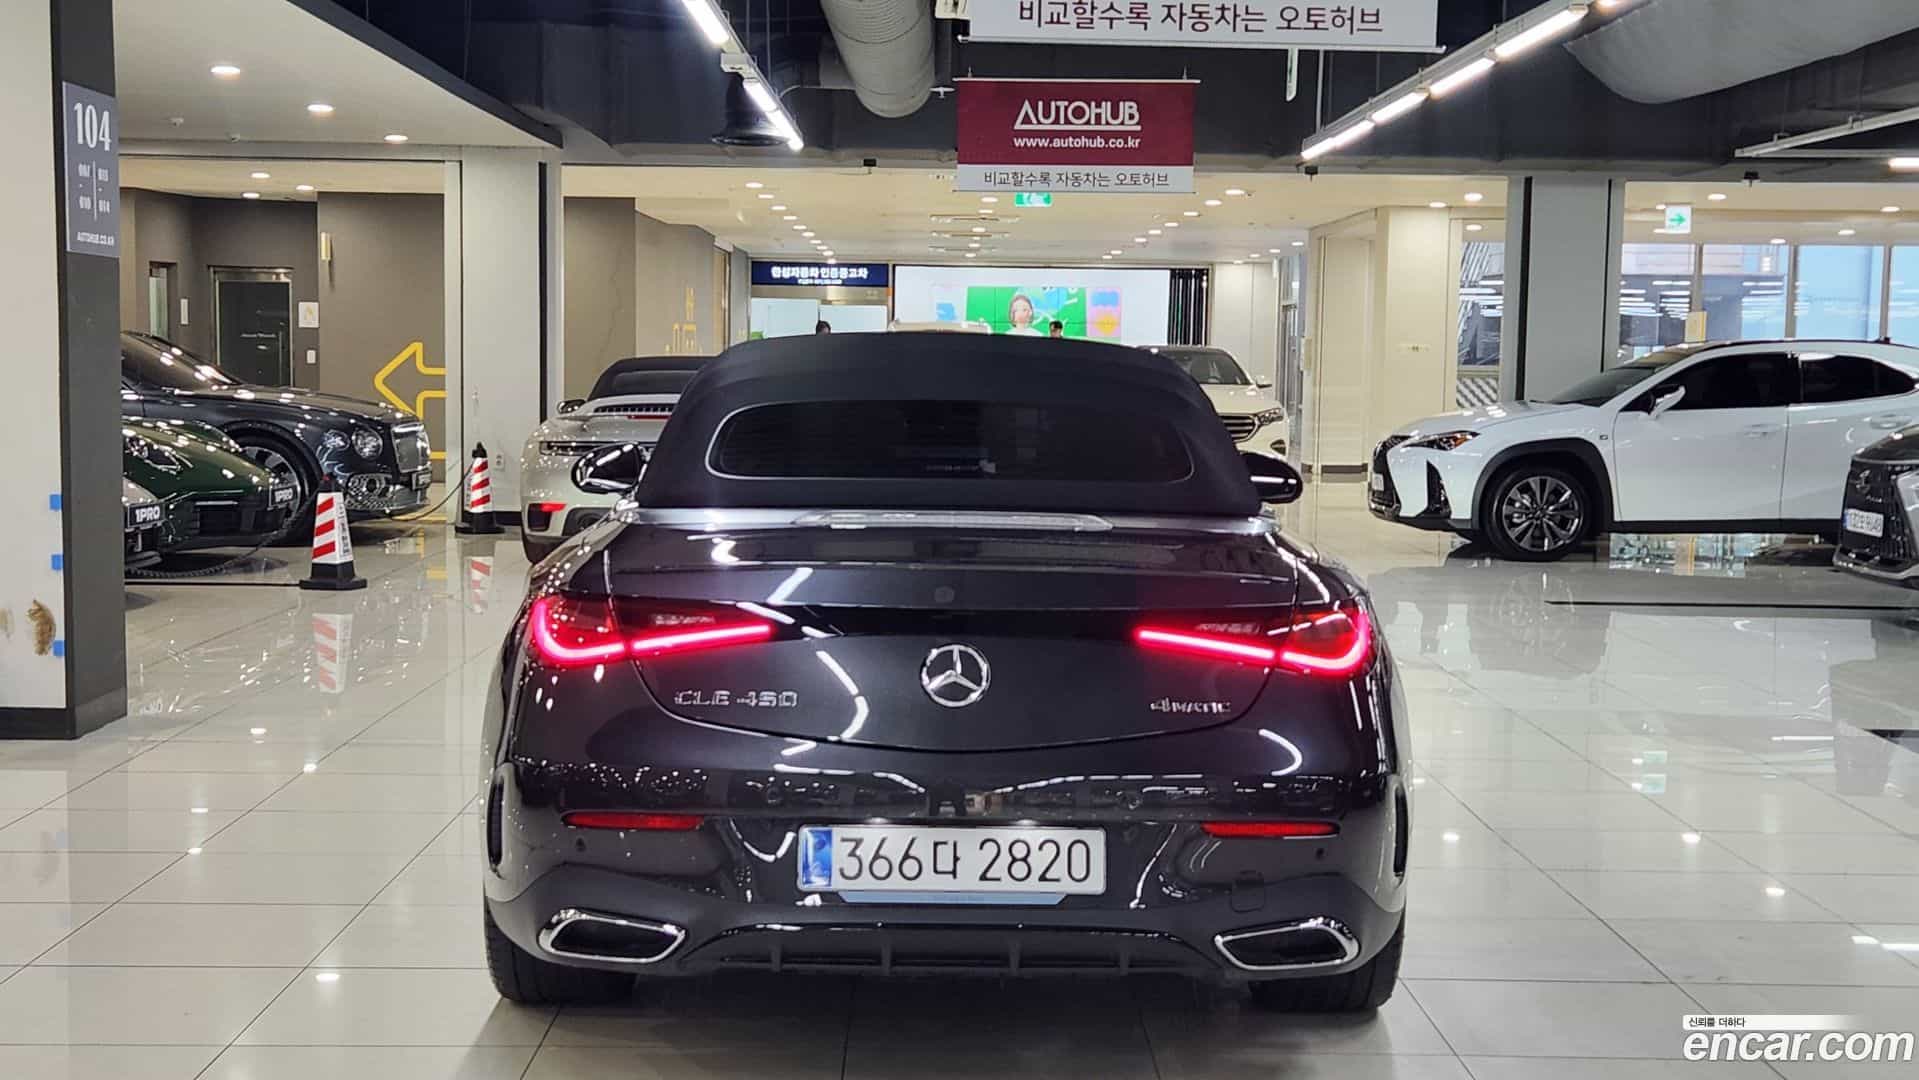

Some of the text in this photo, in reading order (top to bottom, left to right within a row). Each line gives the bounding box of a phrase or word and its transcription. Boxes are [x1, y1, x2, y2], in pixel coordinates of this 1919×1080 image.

[1018, 0, 1384, 35] 비교할수록 자동차는 오토허브
[1013, 99, 1142, 130] AUTOHUB
[74, 102, 112, 151] 104
[1013, 136, 1142, 149] www.autohub.co.kr
[984, 171, 1170, 188] 비교할수록 자동차는 오토허브
[135, 504, 161, 523] 1PRO
[674, 689, 798, 707] CLE 450
[1150, 697, 1231, 713] 4MATIC
[838, 836, 1091, 882] 366다 2820
